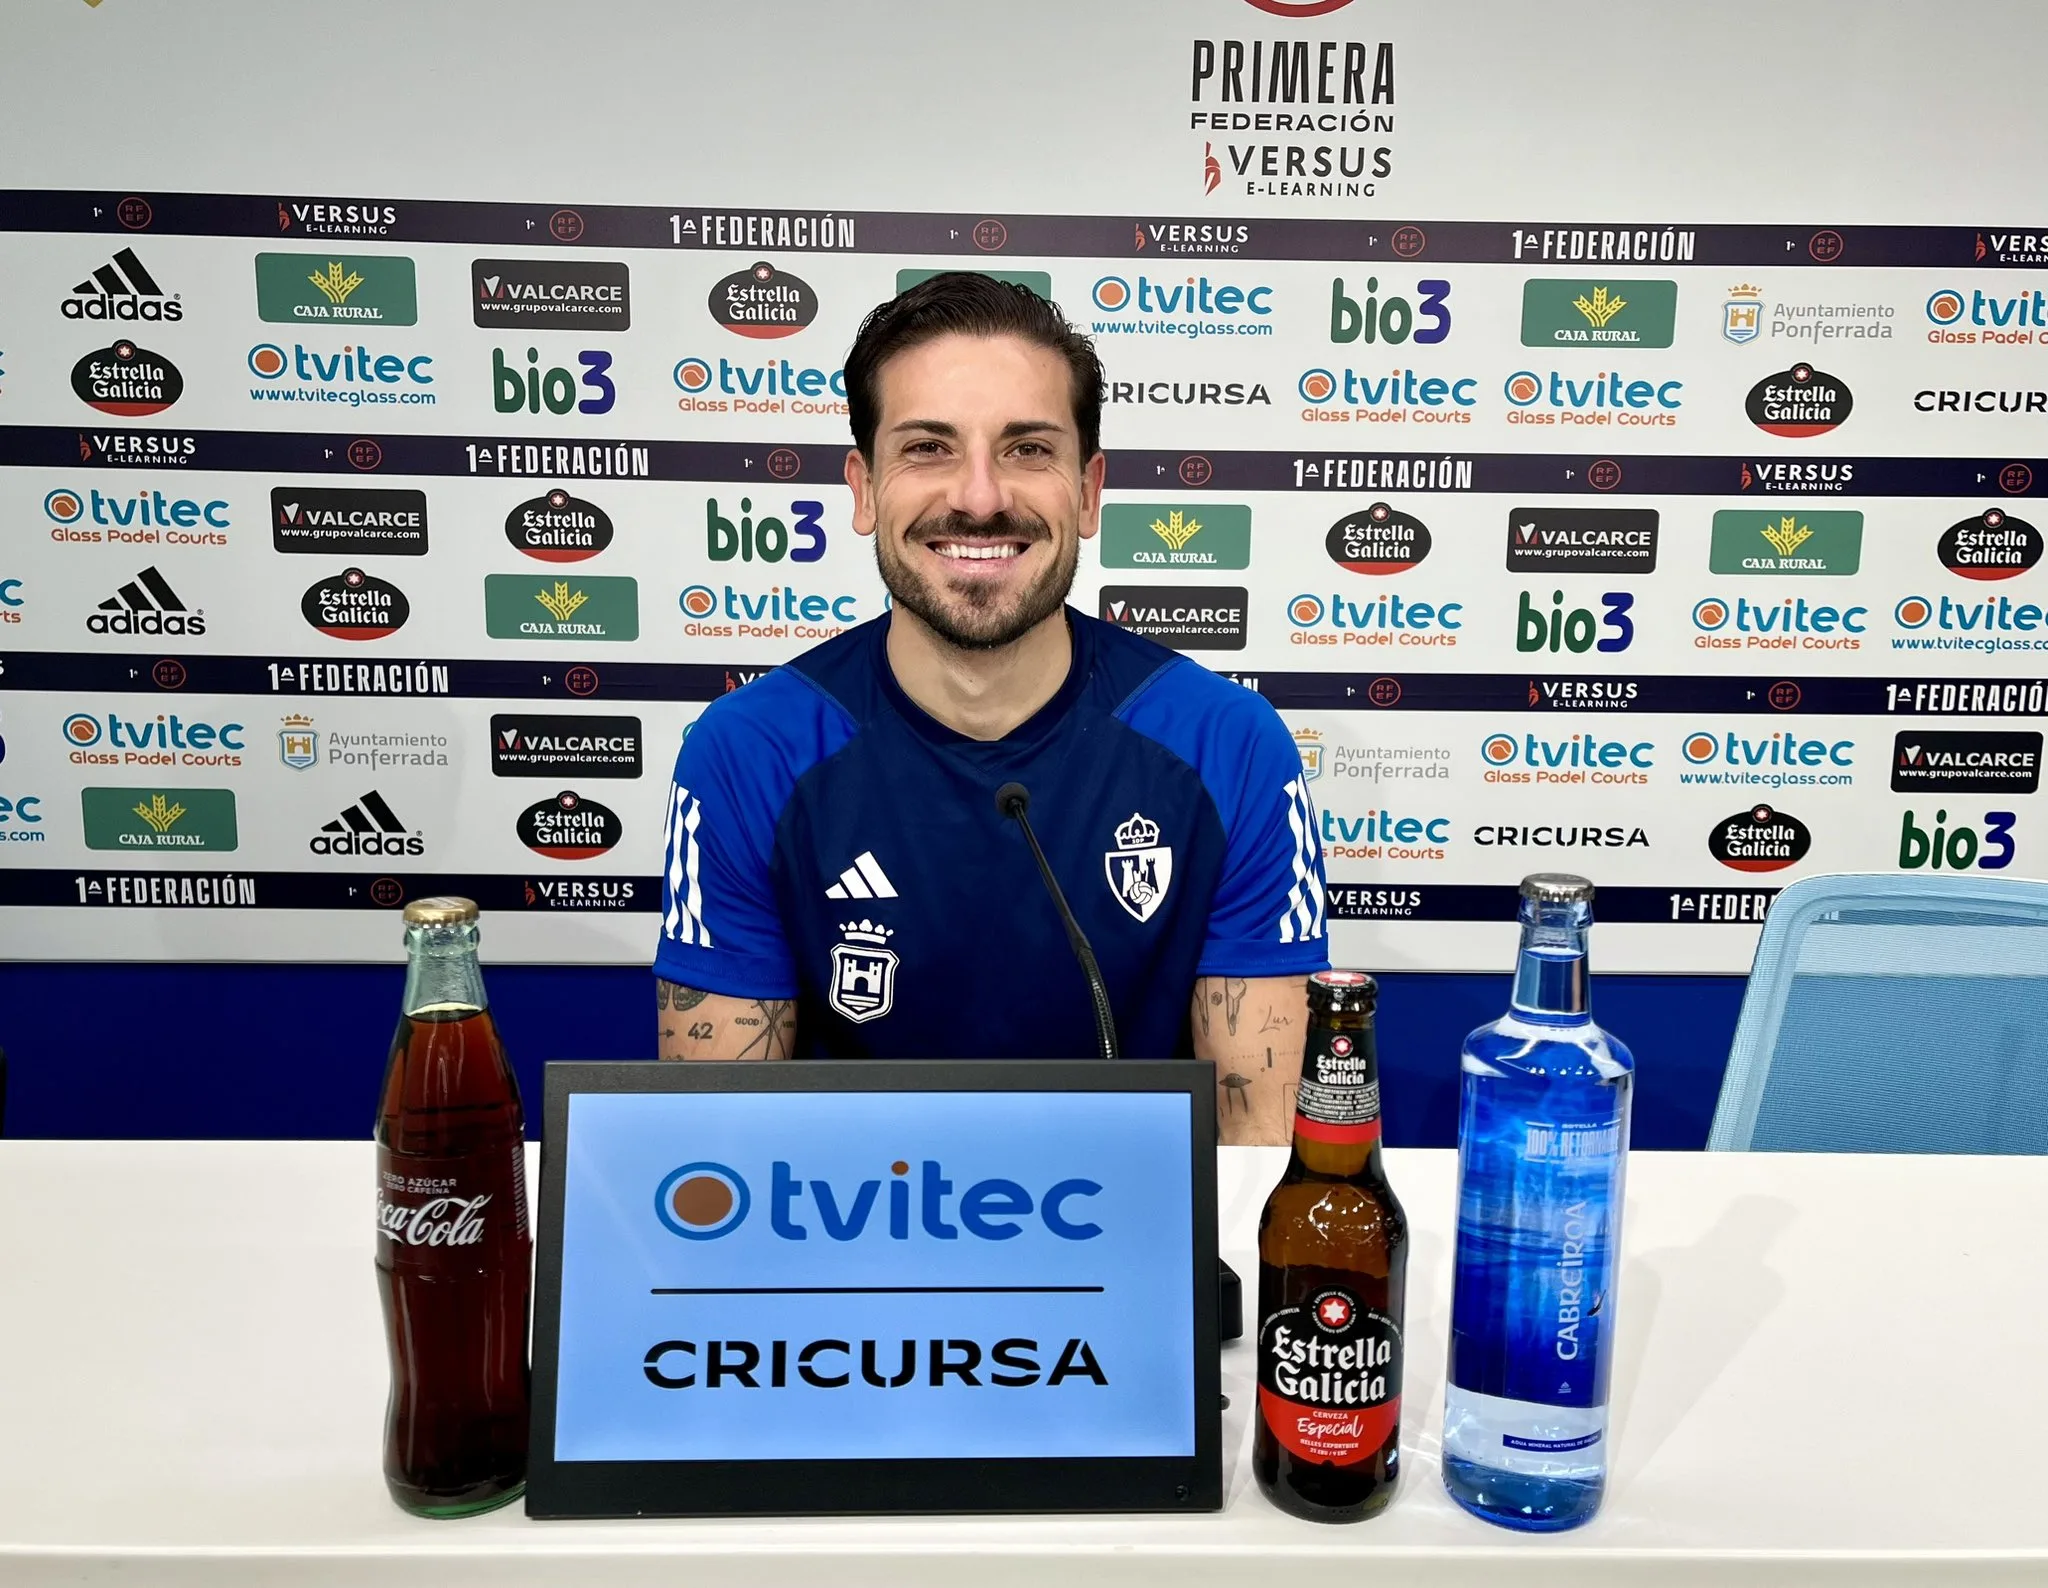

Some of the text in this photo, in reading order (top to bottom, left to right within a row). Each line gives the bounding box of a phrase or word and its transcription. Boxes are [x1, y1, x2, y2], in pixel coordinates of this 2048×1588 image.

[1191, 40, 1394, 104] PRIMERA
[1191, 110, 1393, 133] FEDERACIÓN
[1228, 145, 1392, 178] VERSUS
[1246, 182, 1375, 197] E-LEARNING
[293, 203, 397, 225] VERSUS
[306, 224, 387, 235] E-LEARNING
[702, 214, 855, 248] FEDERACIÓN
[1149, 225, 1248, 243] VERSUS
[1161, 244, 1239, 253] E-LEARNING
[1542, 227, 1695, 261] FEDERACIÓN
[507, 285, 622, 301] VALCARCE
[726, 284, 800, 304] Estrella
[1138, 277, 1273, 315] tvitec
[61, 293, 183, 321] adidas
[293, 306, 382, 319] CAJA RURAL
[481, 302, 622, 314] www.grupovalcarce.com
[730, 301, 797, 321] Galicia
[1330, 277, 1451, 345] bio3
[1774, 302, 1894, 321] Ayuntamiento
[1092, 320, 1272, 338] www.tvitecglass.com
[1554, 330, 1639, 342] CAJA RURAL
[1771, 322, 1893, 344] Ponferrada
[89, 362, 164, 382] Estrella
[295, 344, 433, 384] tvitec
[93, 379, 162, 399] Galicia
[493, 347, 615, 414] bio3
[1344, 369, 1477, 405] tvitec
[250, 388, 436, 407] www.tvitecglass.com
[1551, 372, 1683, 409] tvitec
[1763, 385, 1836, 403] Estrella
[679, 399, 849, 415] Glass Padel Courts
[1302, 409, 1471, 423] Glass Padel Courts
[1764, 404, 1831, 421] Galicia
[1507, 411, 1675, 427] Glass Padel Courts
[93, 435, 195, 454] VERSUS
[107, 454, 187, 464] E-LEARNING
[498, 443, 649, 475] FEDERACIÓN
[1324, 456, 1472, 488] FEDERACIÓN
[1755, 464, 1853, 482] VERSUS
[1766, 482, 1843, 491] E-LEARNING
[91, 489, 231, 528] tvitec
[307, 512, 420, 528] VALCARCE
[522, 511, 595, 529] Estrella
[51, 529, 227, 545] Glass Padel Courts
[281, 528, 420, 541] www.grupovalcarce.com
[526, 528, 593, 547] Galicia
[707, 497, 827, 563] bio3
[1343, 524, 1414, 542] Estrella
[1541, 530, 1651, 546] VALCARCE
[1955, 530, 2027, 548] Estrella
[1133, 551, 1216, 564] CAJA RURAL
[1345, 541, 1410, 559] Galicia
[1515, 548, 1650, 560] www.grupovalcarce.com
[1956, 547, 2023, 565] Galicia
[1742, 558, 1826, 570] CAJA RURAL
[319, 589, 391, 607] Estrella
[724, 586, 856, 622] tvitec
[322, 606, 389, 625] Galicia
[1132, 608, 1240, 622] VALCARCE
[1332, 594, 1463, 629] tvitec
[1736, 598, 1868, 633] tvitec
[86, 610, 205, 635] adidas
[520, 622, 605, 635] CAJA RURAL
[1516, 590, 1634, 653] bio3
[684, 624, 789, 638] Glass Padel
[1291, 632, 1456, 646] Glass Padel Courts
[1694, 636, 1860, 650] Glass Padel Courts
[300, 661, 448, 693] FEDERACIÓN
[1543, 682, 1638, 700] VERSUS
[1553, 699, 1627, 708] E-LEARNING
[109, 714, 244, 750] tvitec
[329, 732, 447, 748] Ayuntamiento
[525, 737, 634, 752] VALCARCE
[1335, 746, 1450, 760] Ayuntamiento
[1526, 733, 1654, 768] tvitec
[1726, 732, 1855, 766] tvitec
[69, 752, 242, 766] Glass Padel Courts
[329, 749, 448, 770] Ponferrada
[500, 753, 634, 764] www.grupovalcarce.com
[1926, 752, 2034, 767] VALCARCE
[1334, 763, 1449, 783] Ponferrada
[1484, 771, 1648, 785] Glass Padel Courts
[1680, 772, 1852, 788] www.tvitecglass.com
[1899, 768, 2032, 779] www.grupovalcarce.com
[533, 811, 604, 828] Estrella
[1323, 810, 1450, 843] tvitec
[119, 834, 204, 846] CAJA RURAL
[537, 828, 602, 845] Galicia
[1474, 826, 1650, 847] CRICURSA
[1726, 824, 1795, 841] Estrella
[1899, 810, 2016, 870] bio3
[309, 832, 424, 856] adidas
[1334, 846, 1444, 859] Padel Courts
[1727, 841, 1790, 856] Galicia
[107, 875, 255, 904] FEDERACIÓN
[538, 882, 634, 898] VERSUS
[1328, 891, 1420, 906] VERSUS
[1339, 907, 1412, 915] E-LEARNING
[688, 1022, 713, 1039] 42
[1317, 1056, 1366, 1071] Estrella
[1318, 1070, 1364, 1085] Galicia
[408, 1178, 456, 1187] AZÚCAR
[771, 1160, 1103, 1241] tvitec
[1272, 1325, 1392, 1370] Estrella
[643, 1338, 1109, 1389] CRICURSA
[1275, 1362, 1386, 1404] Galicia
[1313, 1411, 1348, 1419] CERVEZA
[1297, 1415, 1363, 1439] Especial
